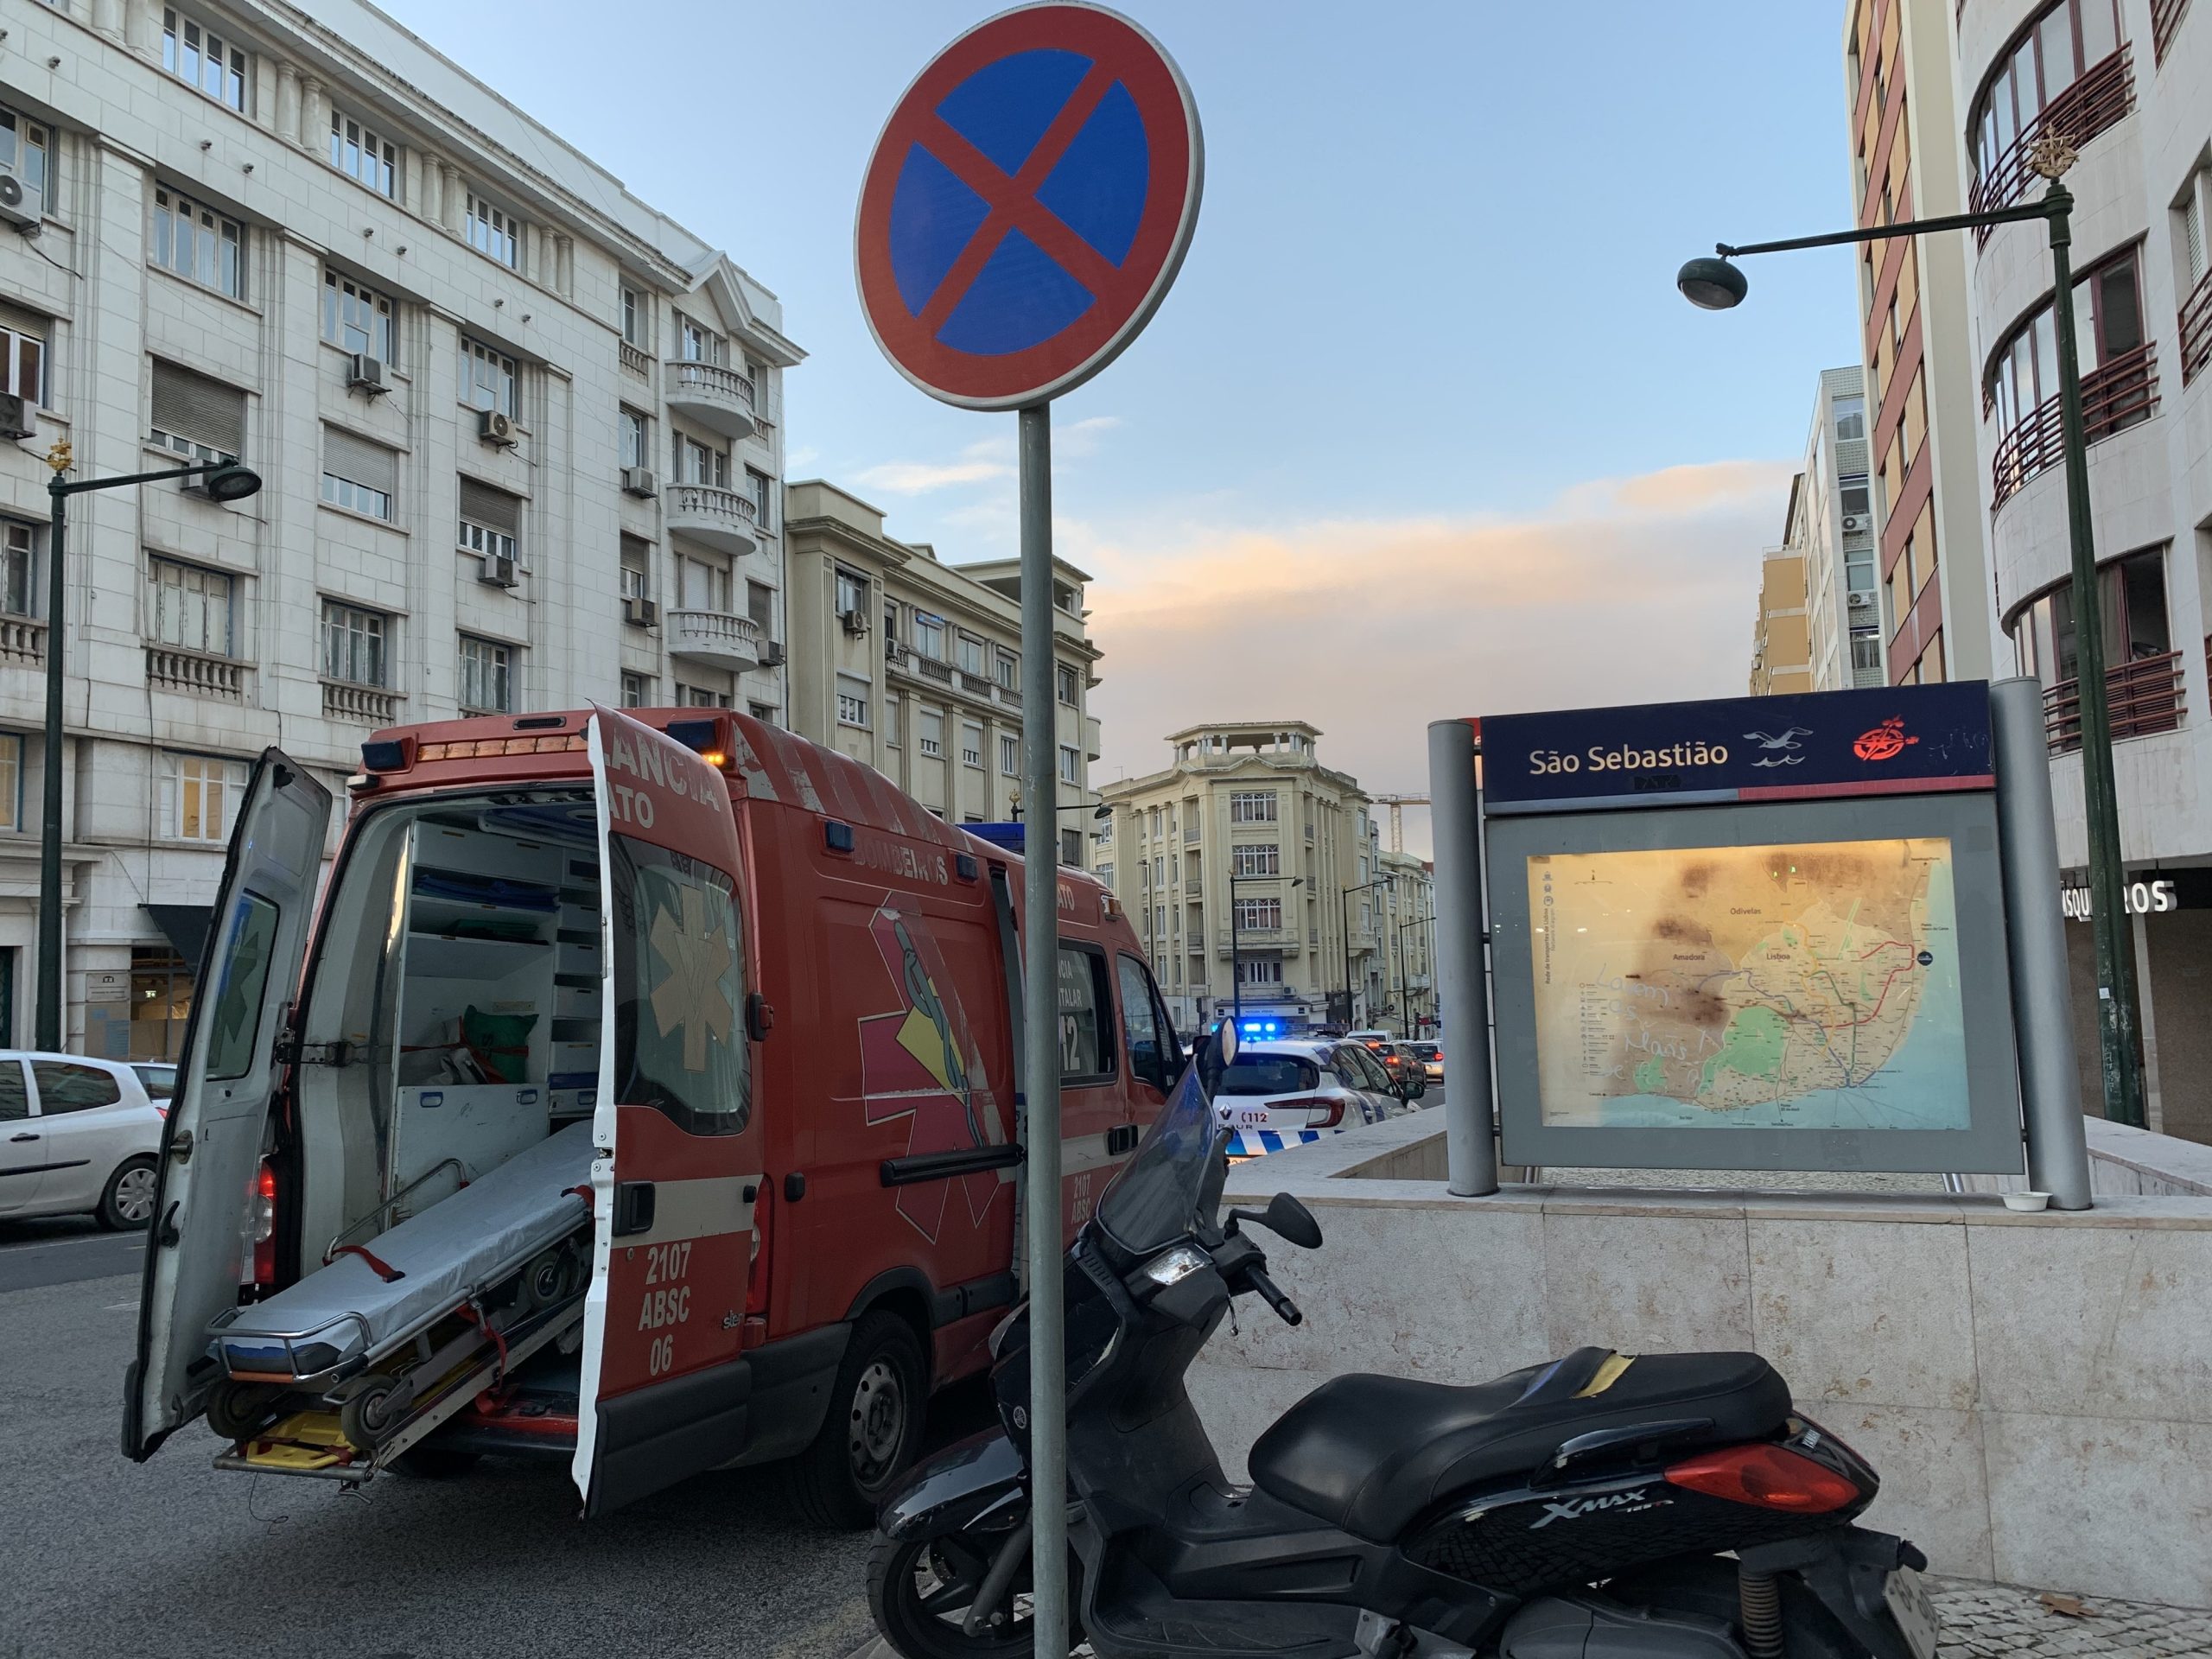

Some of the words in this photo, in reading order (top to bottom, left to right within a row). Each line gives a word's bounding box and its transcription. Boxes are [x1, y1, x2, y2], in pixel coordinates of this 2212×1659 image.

[603, 725, 721, 812] ANCIA
[1529, 750, 1580, 774] São
[1588, 741, 1728, 771] Sebastião
[1248, 1113, 1268, 1122] 112
[1073, 1174, 1091, 1199] 2107
[1071, 1198, 1091, 1224] ABSC
[645, 1242, 692, 1285] 2107
[638, 1285, 691, 1332] ABSC
[649, 1333, 674, 1376] 06
